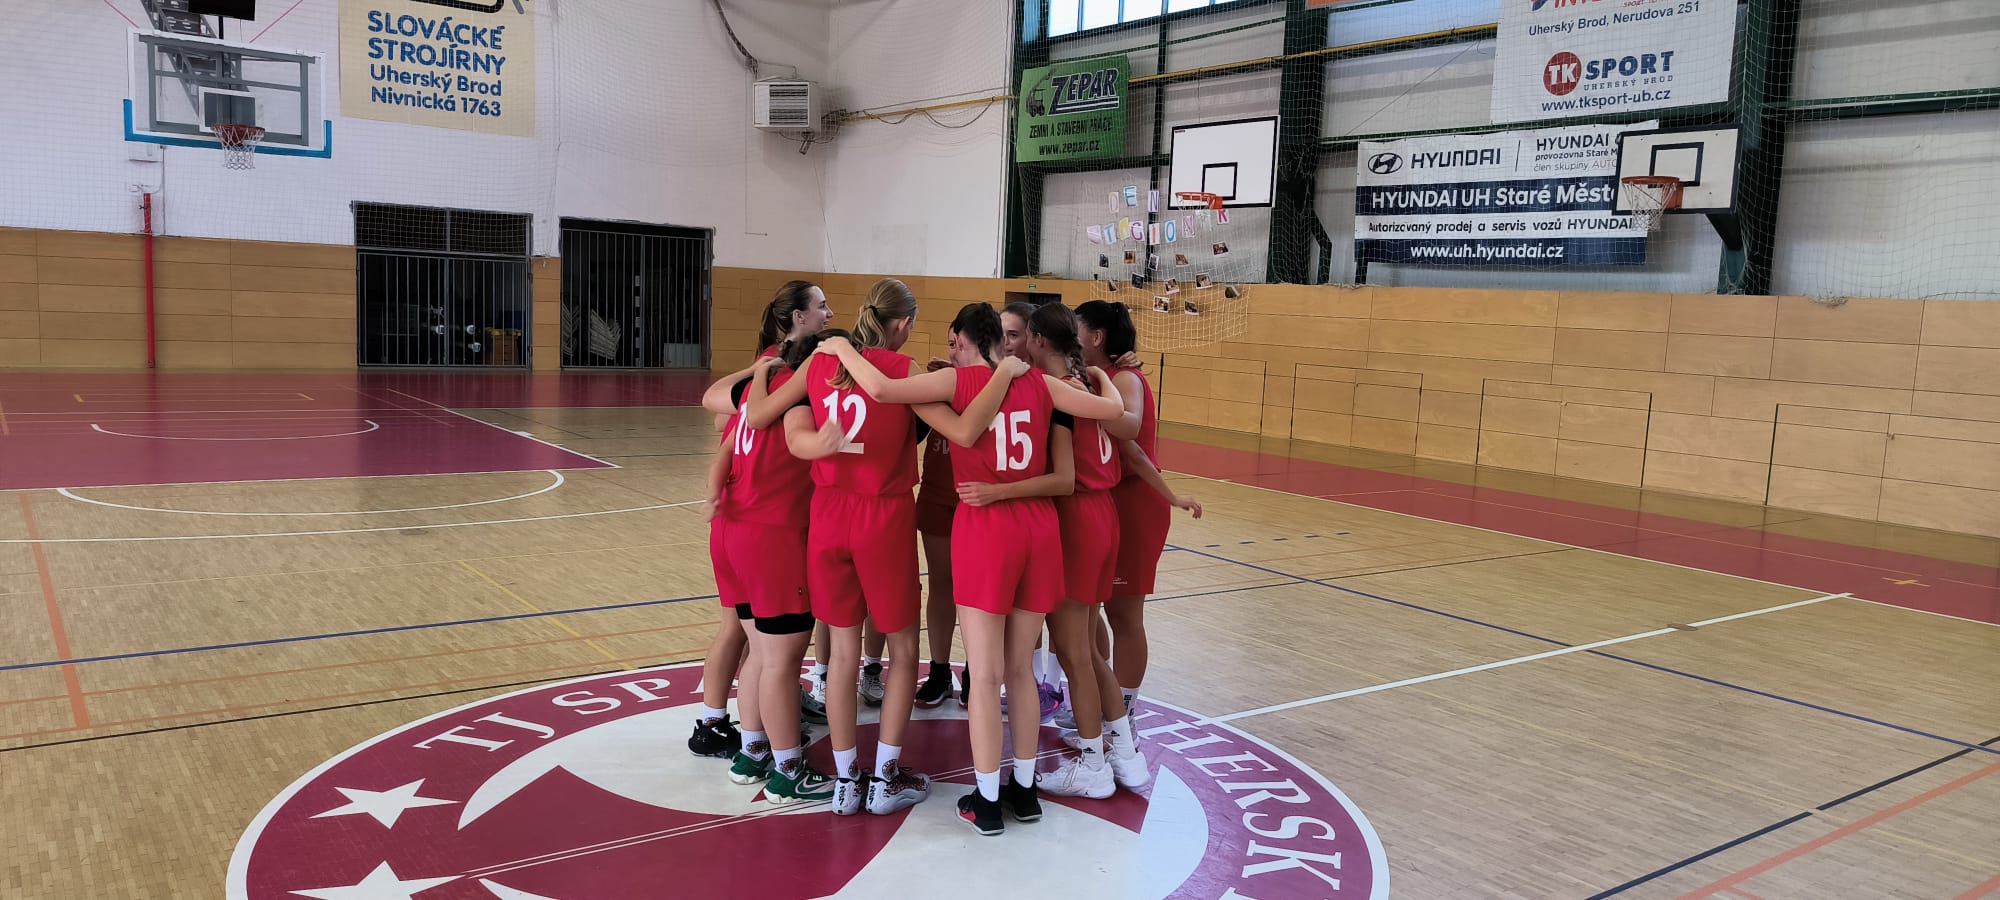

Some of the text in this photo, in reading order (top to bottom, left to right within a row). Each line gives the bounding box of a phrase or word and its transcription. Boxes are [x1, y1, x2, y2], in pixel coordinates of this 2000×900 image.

[367, 10, 505, 50] SLOVÁCKÉ
[1528, 0, 1701, 36] Uherský Brod, Nerudova 251
[367, 37, 506, 76] STROJÍRNY
[1548, 50, 1675, 86] TK SPORT
[370, 63, 502, 97] Uherský Brod
[1047, 67, 1119, 117] ZEPAR
[1583, 74, 1674, 91] UHERSKÝ BROD
[371, 86, 501, 117] Nivnická 1763
[1541, 89, 1672, 112] www.tksport-ub.cz
[1050, 122, 1055, 137] A
[1536, 133, 1609, 152] HYUNDAI
[1039, 140, 1100, 156] www.zepar.cz
[1410, 148, 1501, 169] HYUNDAI
[1535, 151, 1584, 161] provozovna
[1586, 149, 1609, 158] Staré
[1533, 162, 1552, 172] člen
[1554, 161, 1589, 172] skupiny
[1372, 182, 1616, 209] HYUNDAI UH Staré Měst
[1436, 220, 1472, 234] prodej
[1477, 223, 1486, 232] a
[1491, 220, 1527, 232] servis
[1532, 218, 1562, 231] vozů
[1567, 217, 1633, 230] HYUNDAI
[1410, 242, 1564, 261] www.uh.hyundai.cz
[822, 389, 868, 455] 12
[988, 409, 1033, 472] 15
[412, 712, 555, 752] TJ
[1134, 709, 1342, 900] HERSK
